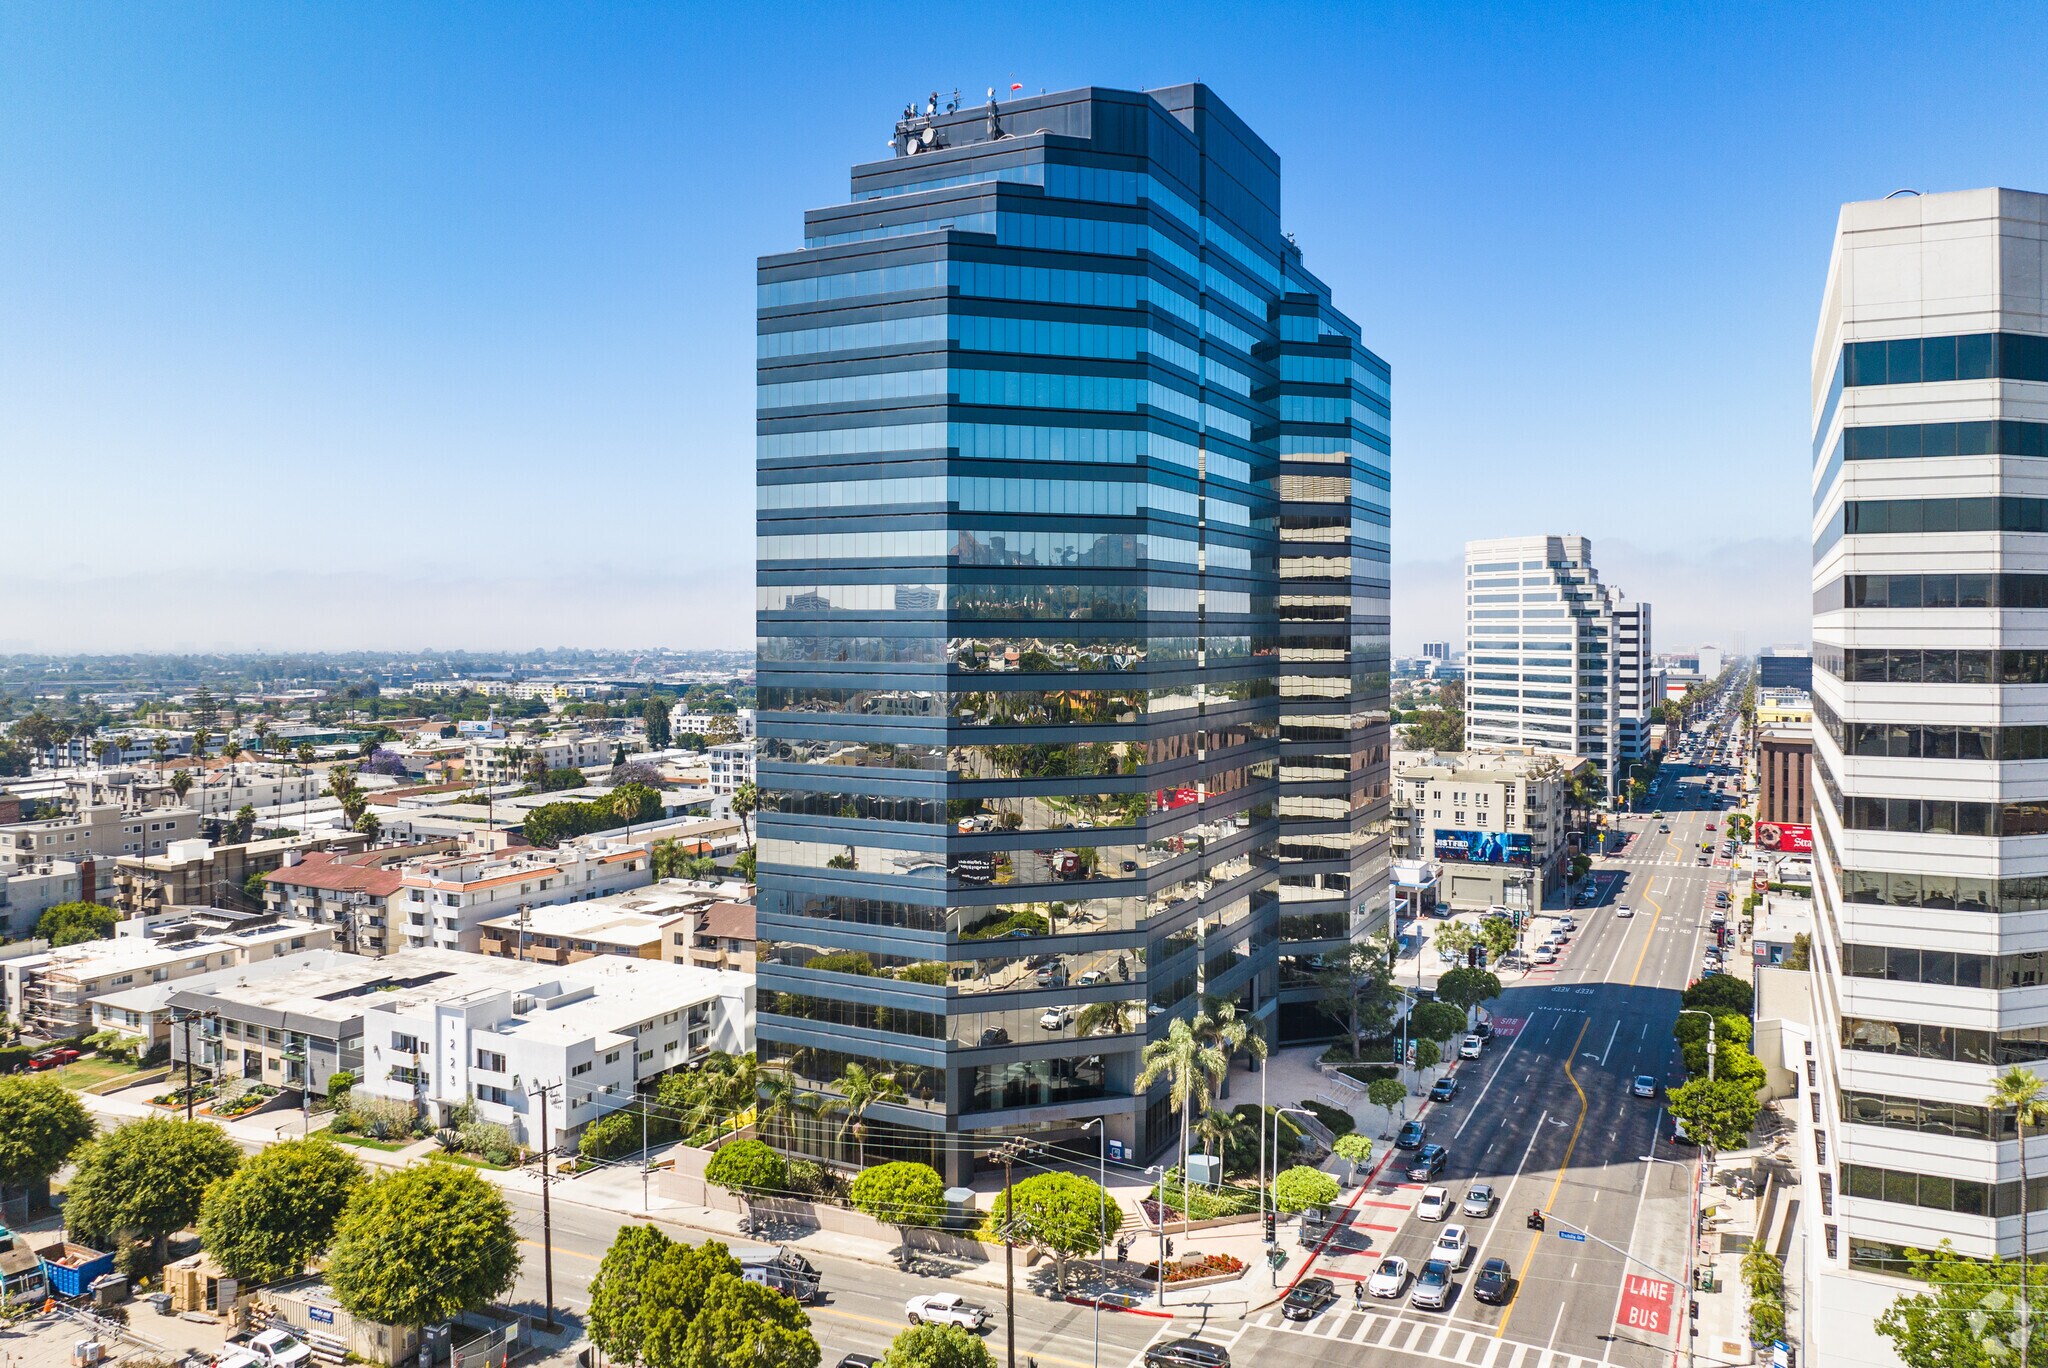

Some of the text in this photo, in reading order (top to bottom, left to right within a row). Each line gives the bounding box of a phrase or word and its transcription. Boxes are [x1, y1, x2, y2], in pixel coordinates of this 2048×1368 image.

[1500, 1017, 1518, 1025] BUS
[1630, 1277, 1668, 1301] LANE
[1628, 1306, 1659, 1329] BUS
